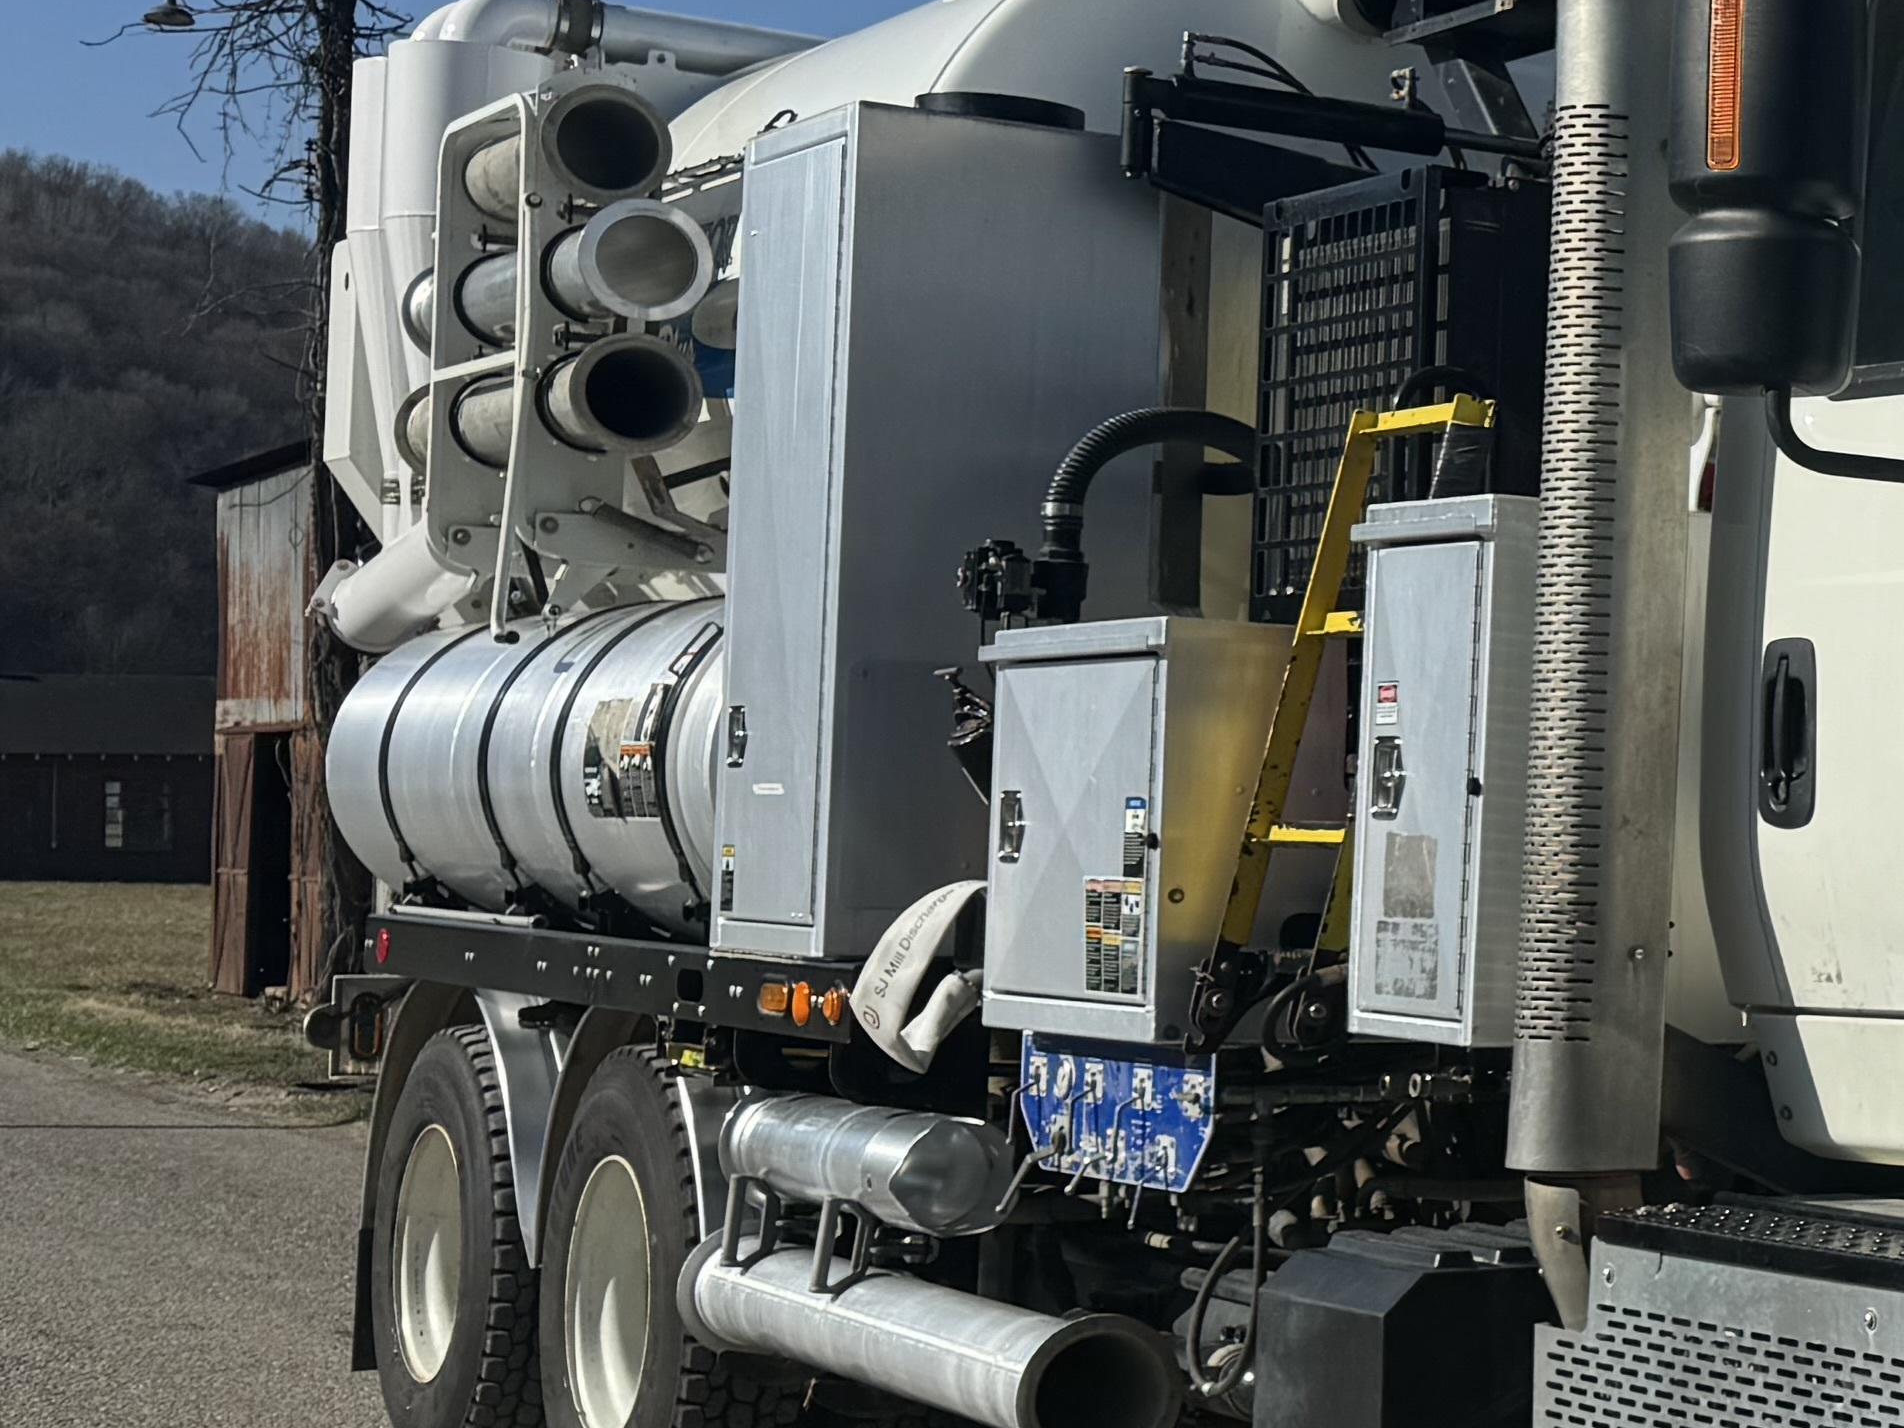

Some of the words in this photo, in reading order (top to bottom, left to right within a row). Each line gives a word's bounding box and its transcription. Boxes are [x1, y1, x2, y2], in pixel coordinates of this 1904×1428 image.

[873, 977, 889, 998] SJ
[884, 952, 906, 978] Mill
[899, 888, 954, 951] Discharg
